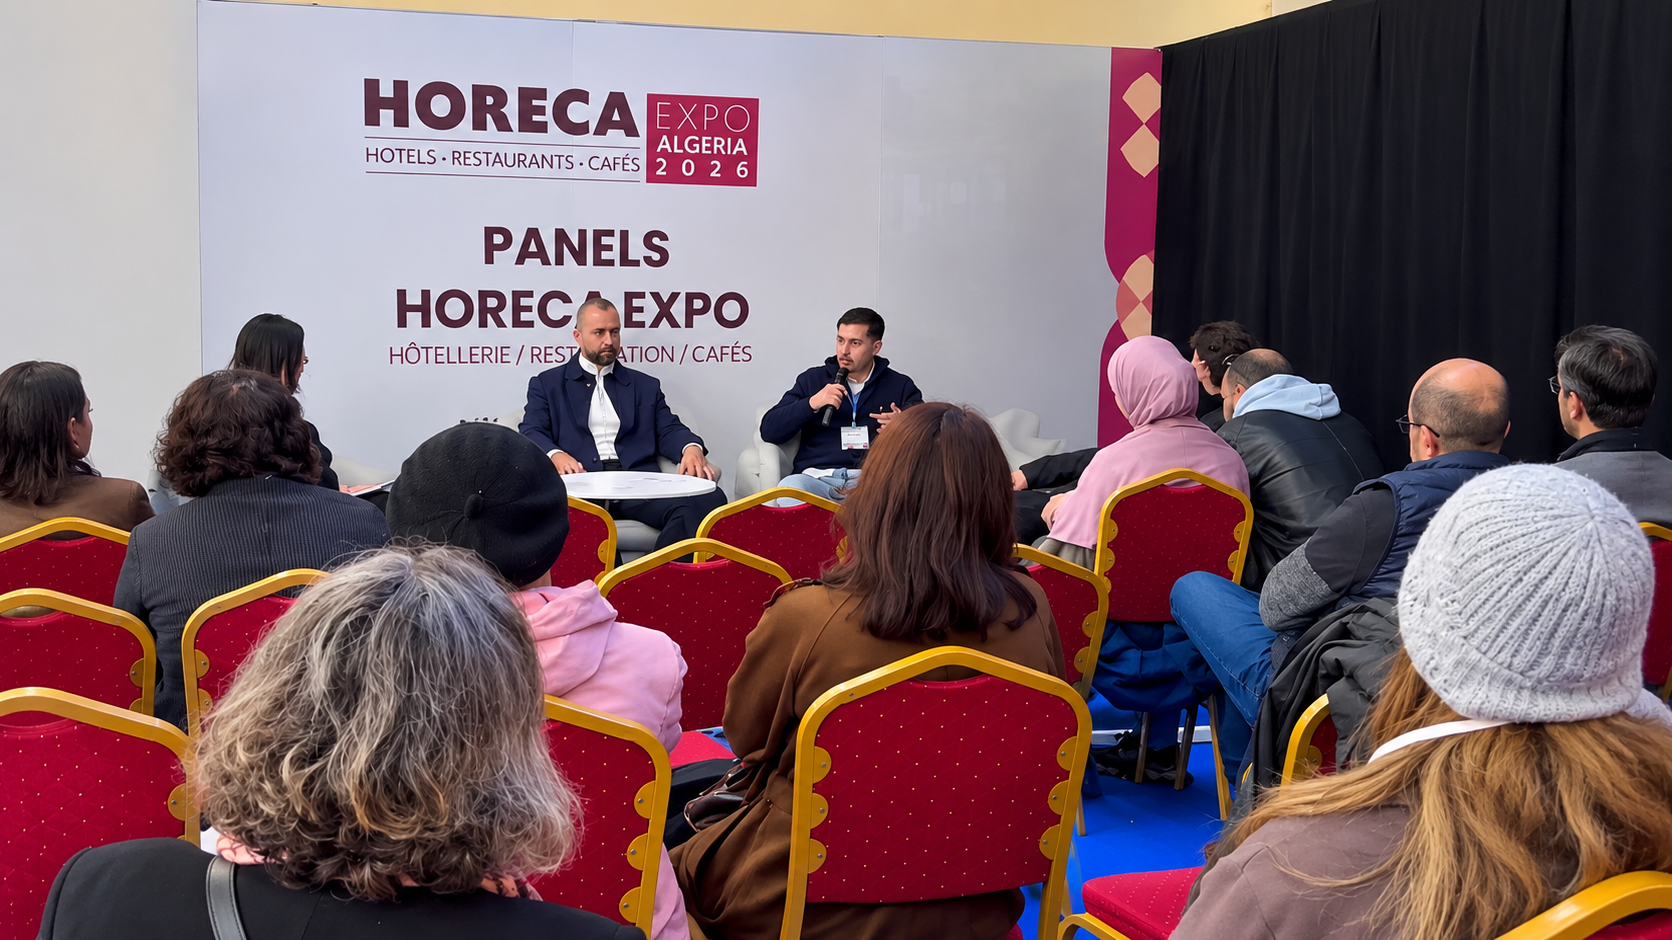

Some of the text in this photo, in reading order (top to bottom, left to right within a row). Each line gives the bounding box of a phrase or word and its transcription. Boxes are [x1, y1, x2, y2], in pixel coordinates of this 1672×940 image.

[363, 78, 641, 138] HORECA
[655, 101, 751, 133] EXPO
[365, 147, 437, 165] HOTELS
[451, 150, 574, 170] RESTAURANTS
[588, 153, 641, 173] CAFÉS
[656, 134, 749, 156] ALGERIA
[483, 226, 670, 268] PANELS
[396, 289, 750, 329] HOREC EXPO
[389, 341, 511, 365] HÔTELLERIE
[530, 345, 675, 364] RESTATION
[691, 340, 753, 363] CAFÉS
